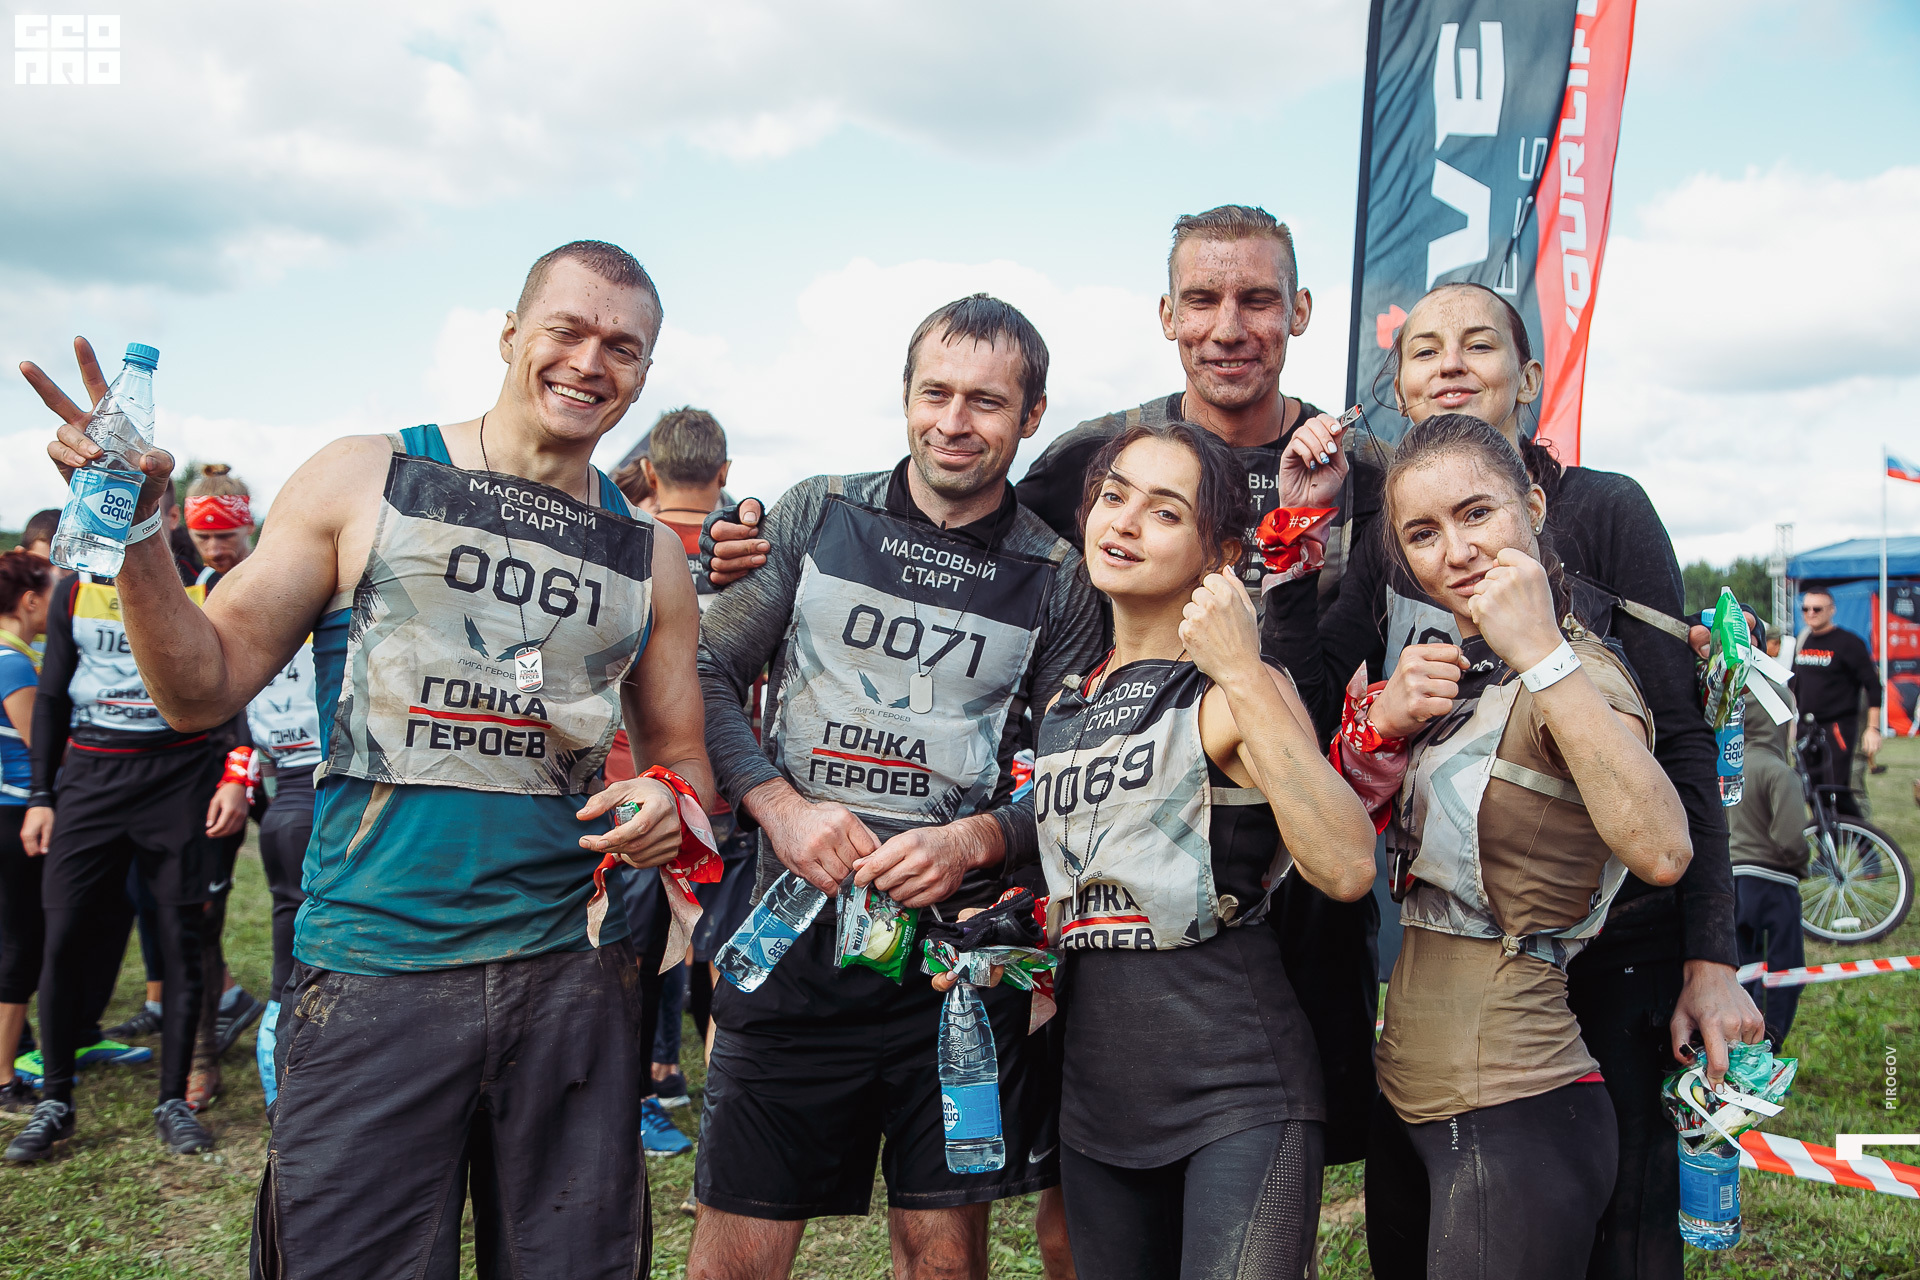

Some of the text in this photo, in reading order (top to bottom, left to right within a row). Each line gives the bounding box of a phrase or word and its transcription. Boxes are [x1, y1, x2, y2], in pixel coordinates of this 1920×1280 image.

[100, 503, 133, 522] aqua
[468, 477, 597, 531] МАССОВЫЙ
[500, 502, 569, 537] СТАРТ
[879, 536, 997, 582] МАССОВЫЙ
[901, 564, 965, 594] СТАРТ
[443, 543, 604, 628] 0061
[841, 603, 987, 679] 0071
[458, 658, 517, 680] ЛИГА ГЕРОЕ
[419, 676, 549, 721] ГОНКА
[854, 705, 912, 723] ЛИГА ГЕРОЕВ
[1085, 705, 1145, 732] СТАРТ
[405, 719, 548, 759] ГЕРОЕВ
[822, 720, 928, 765] ГОНКА
[1723, 750, 1744, 762] aqu
[808, 758, 931, 798] ГЕРОЕВ
[1035, 740, 1156, 825] 0069
[944, 1112, 960, 1124] qua
